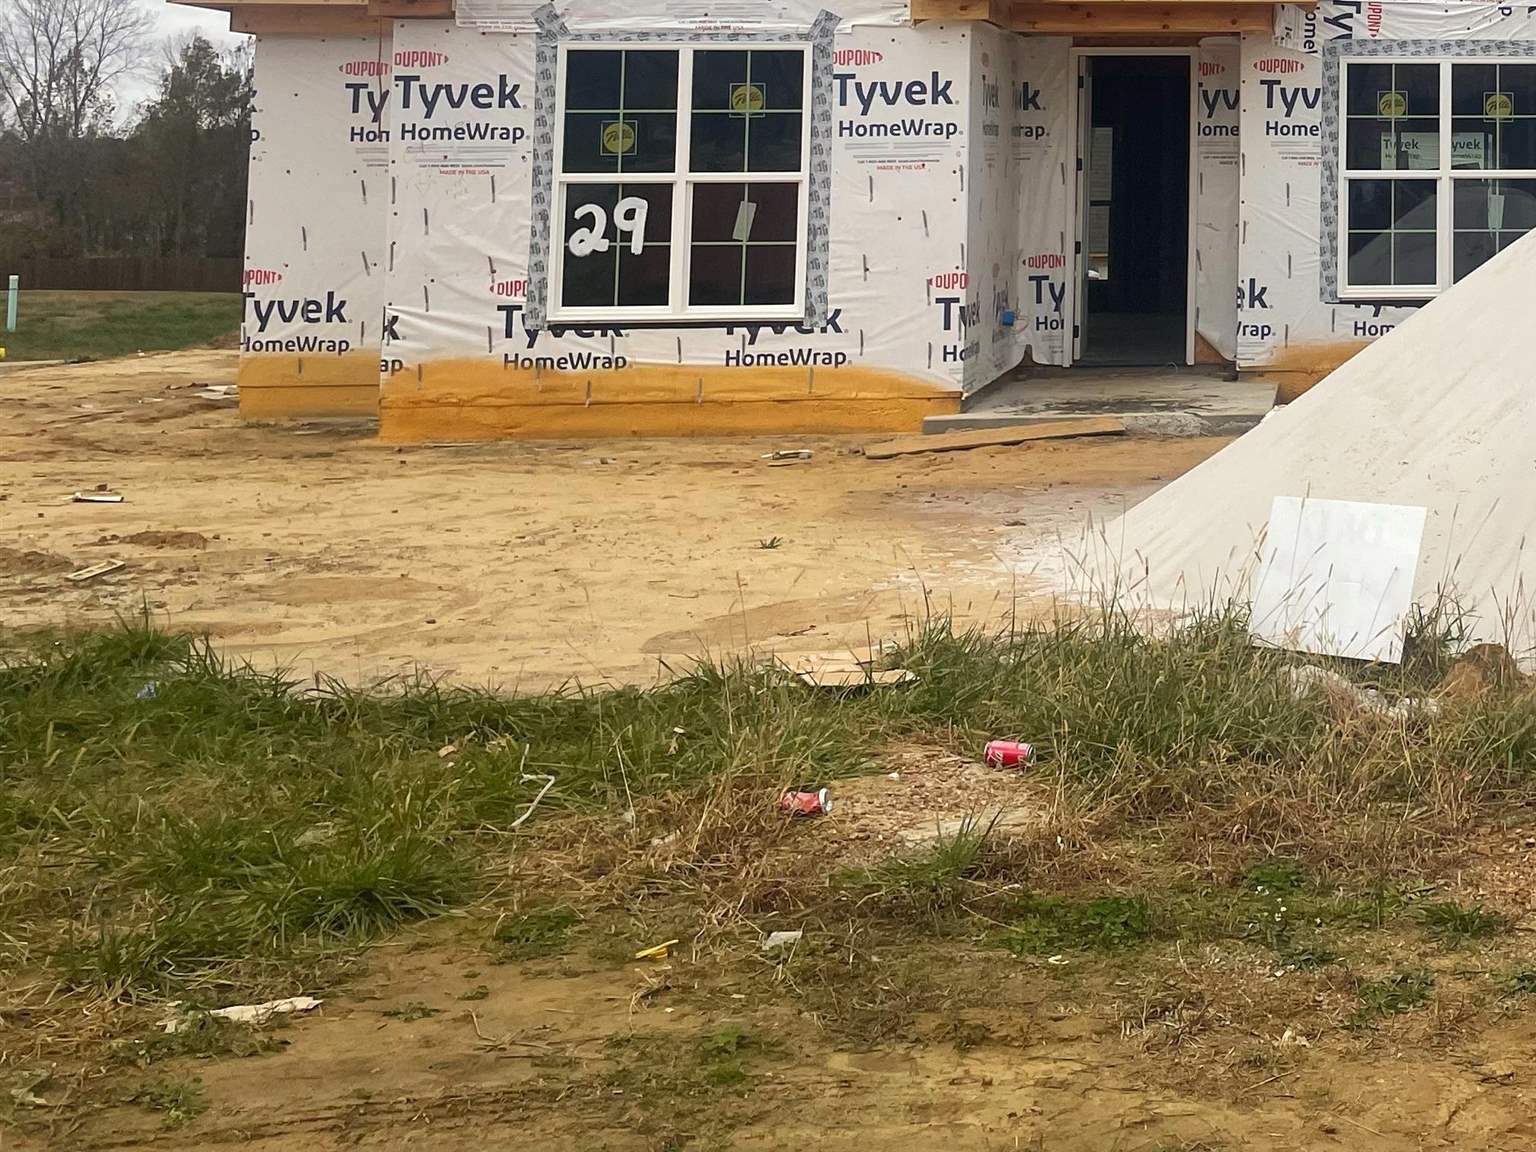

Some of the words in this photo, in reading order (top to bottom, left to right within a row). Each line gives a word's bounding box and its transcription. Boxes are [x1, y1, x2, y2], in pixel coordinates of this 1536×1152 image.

[394, 51, 443, 68] DUPONT
[833, 49, 877, 66] DUPONT
[1259, 59, 1299, 74] DUPONT
[394, 74, 521, 119] Tyvek
[834, 71, 953, 116] Tyvek
[400, 123, 525, 144] HomeWrap
[838, 119, 958, 139] HomeWrap
[568, 196, 649, 257] 29
[242, 291, 347, 333] Tyvek
[504, 352, 628, 372] HomeWrap
[725, 348, 848, 369] HomeWrap
